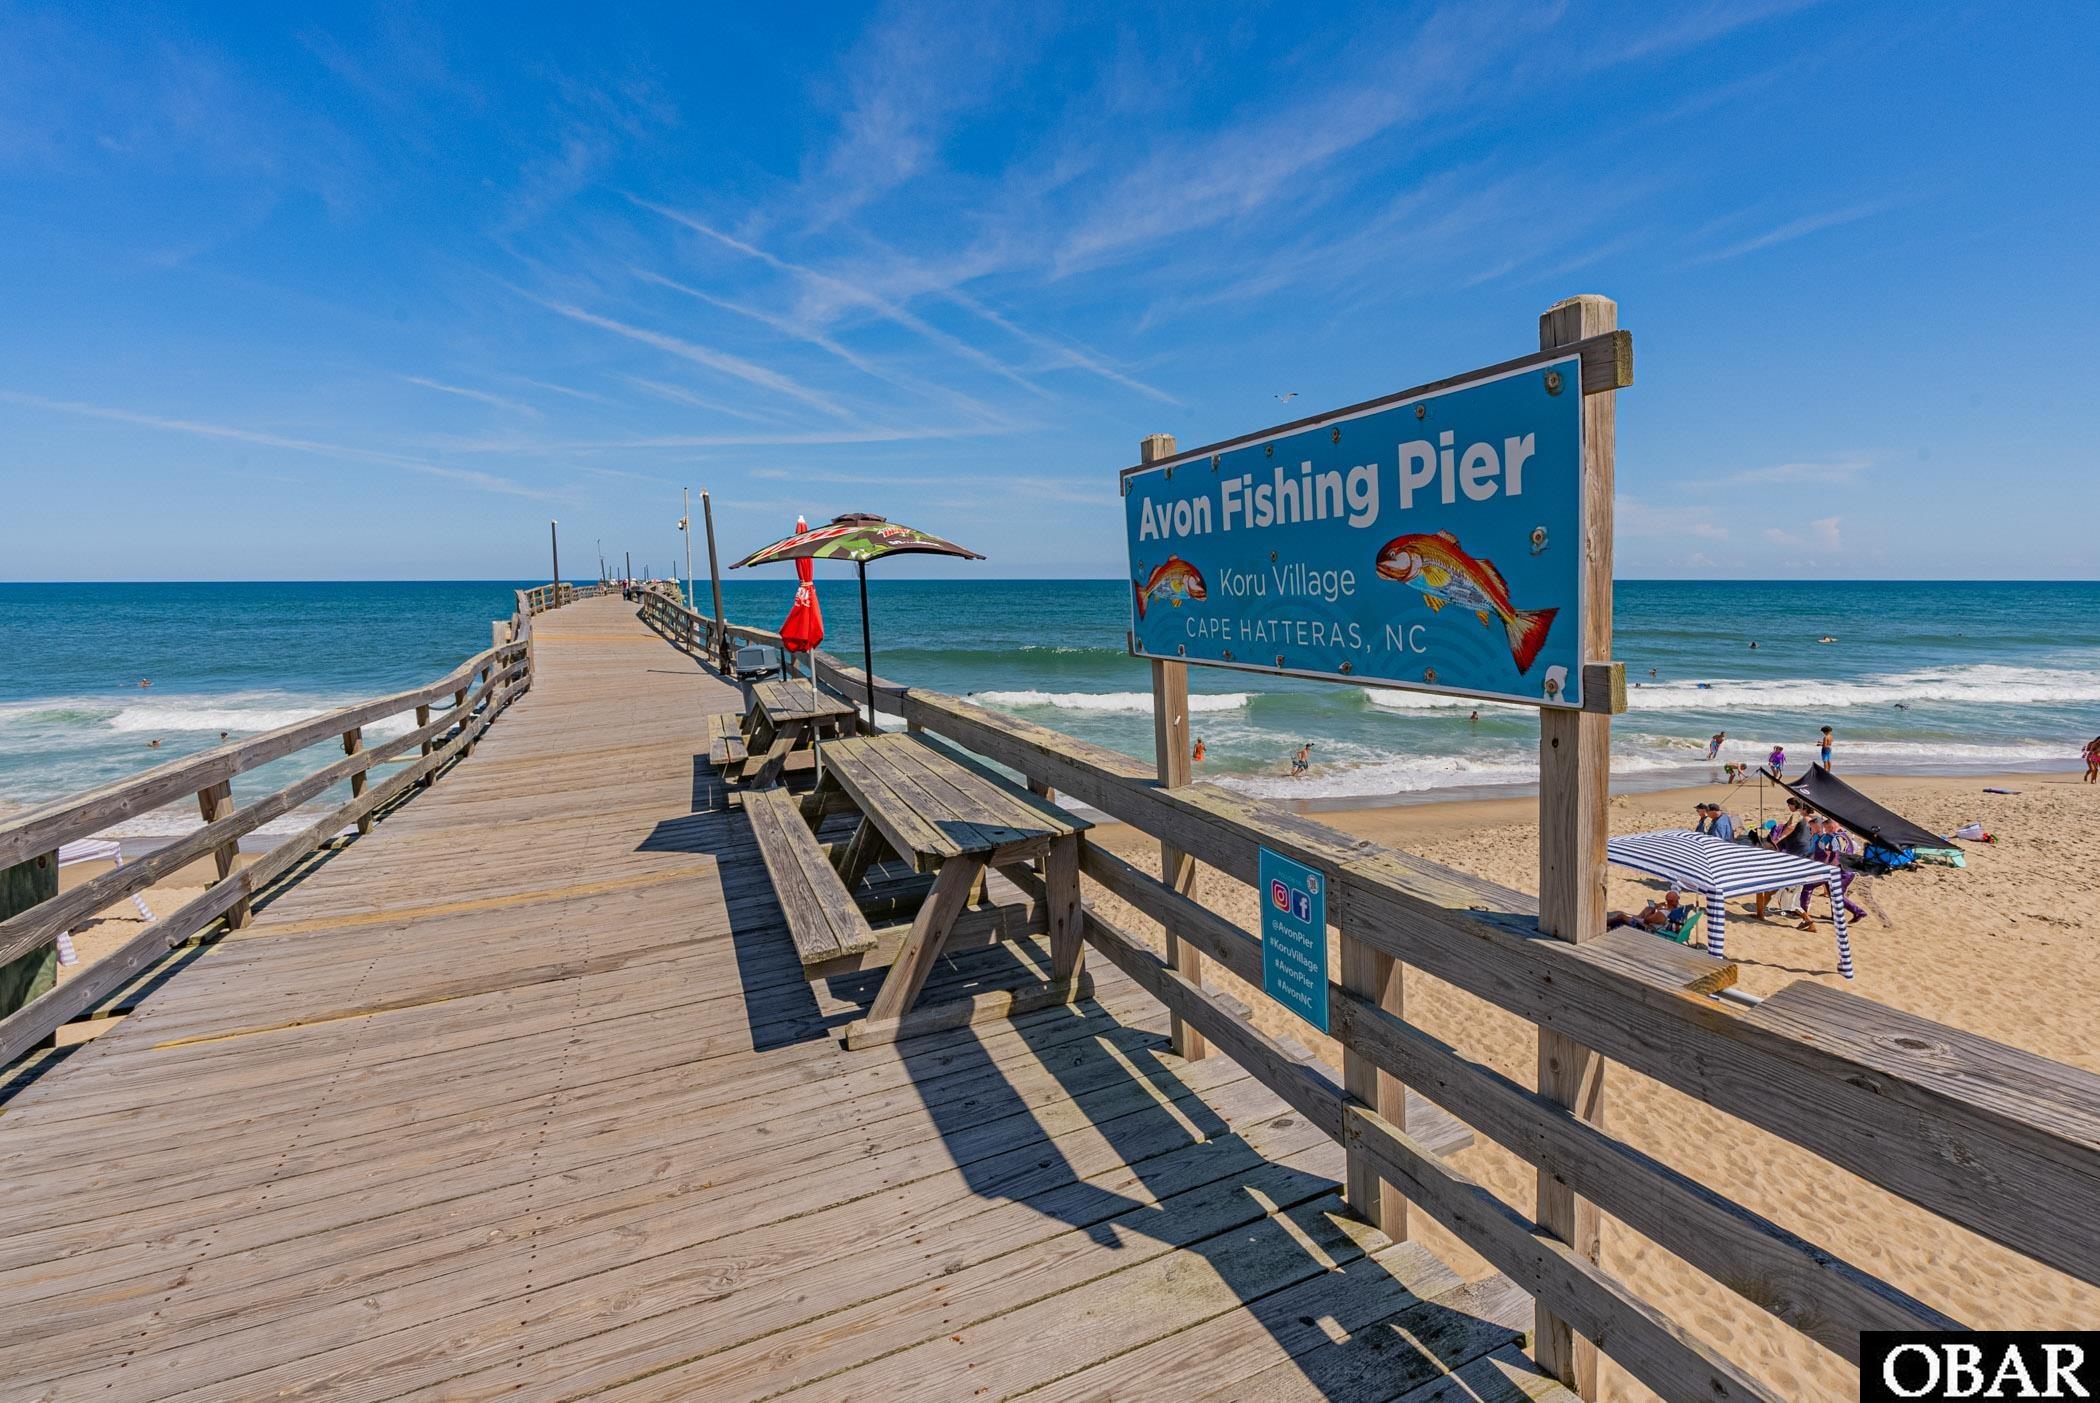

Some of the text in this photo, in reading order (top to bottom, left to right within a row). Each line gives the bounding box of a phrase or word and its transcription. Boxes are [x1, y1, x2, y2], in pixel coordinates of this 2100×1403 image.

[1139, 430, 1535, 541] Avon Fishing Pier
[1219, 562, 1356, 602] Koru Village
[1186, 616, 1427, 654] CAPE HATTERAS, NC
[1271, 919, 1314, 949] @AvonPier
[1269, 936, 1319, 973] #KoruVillage
[1275, 957, 1314, 990] #AvonPier
[1277, 978, 1313, 1009] #AvonNC
